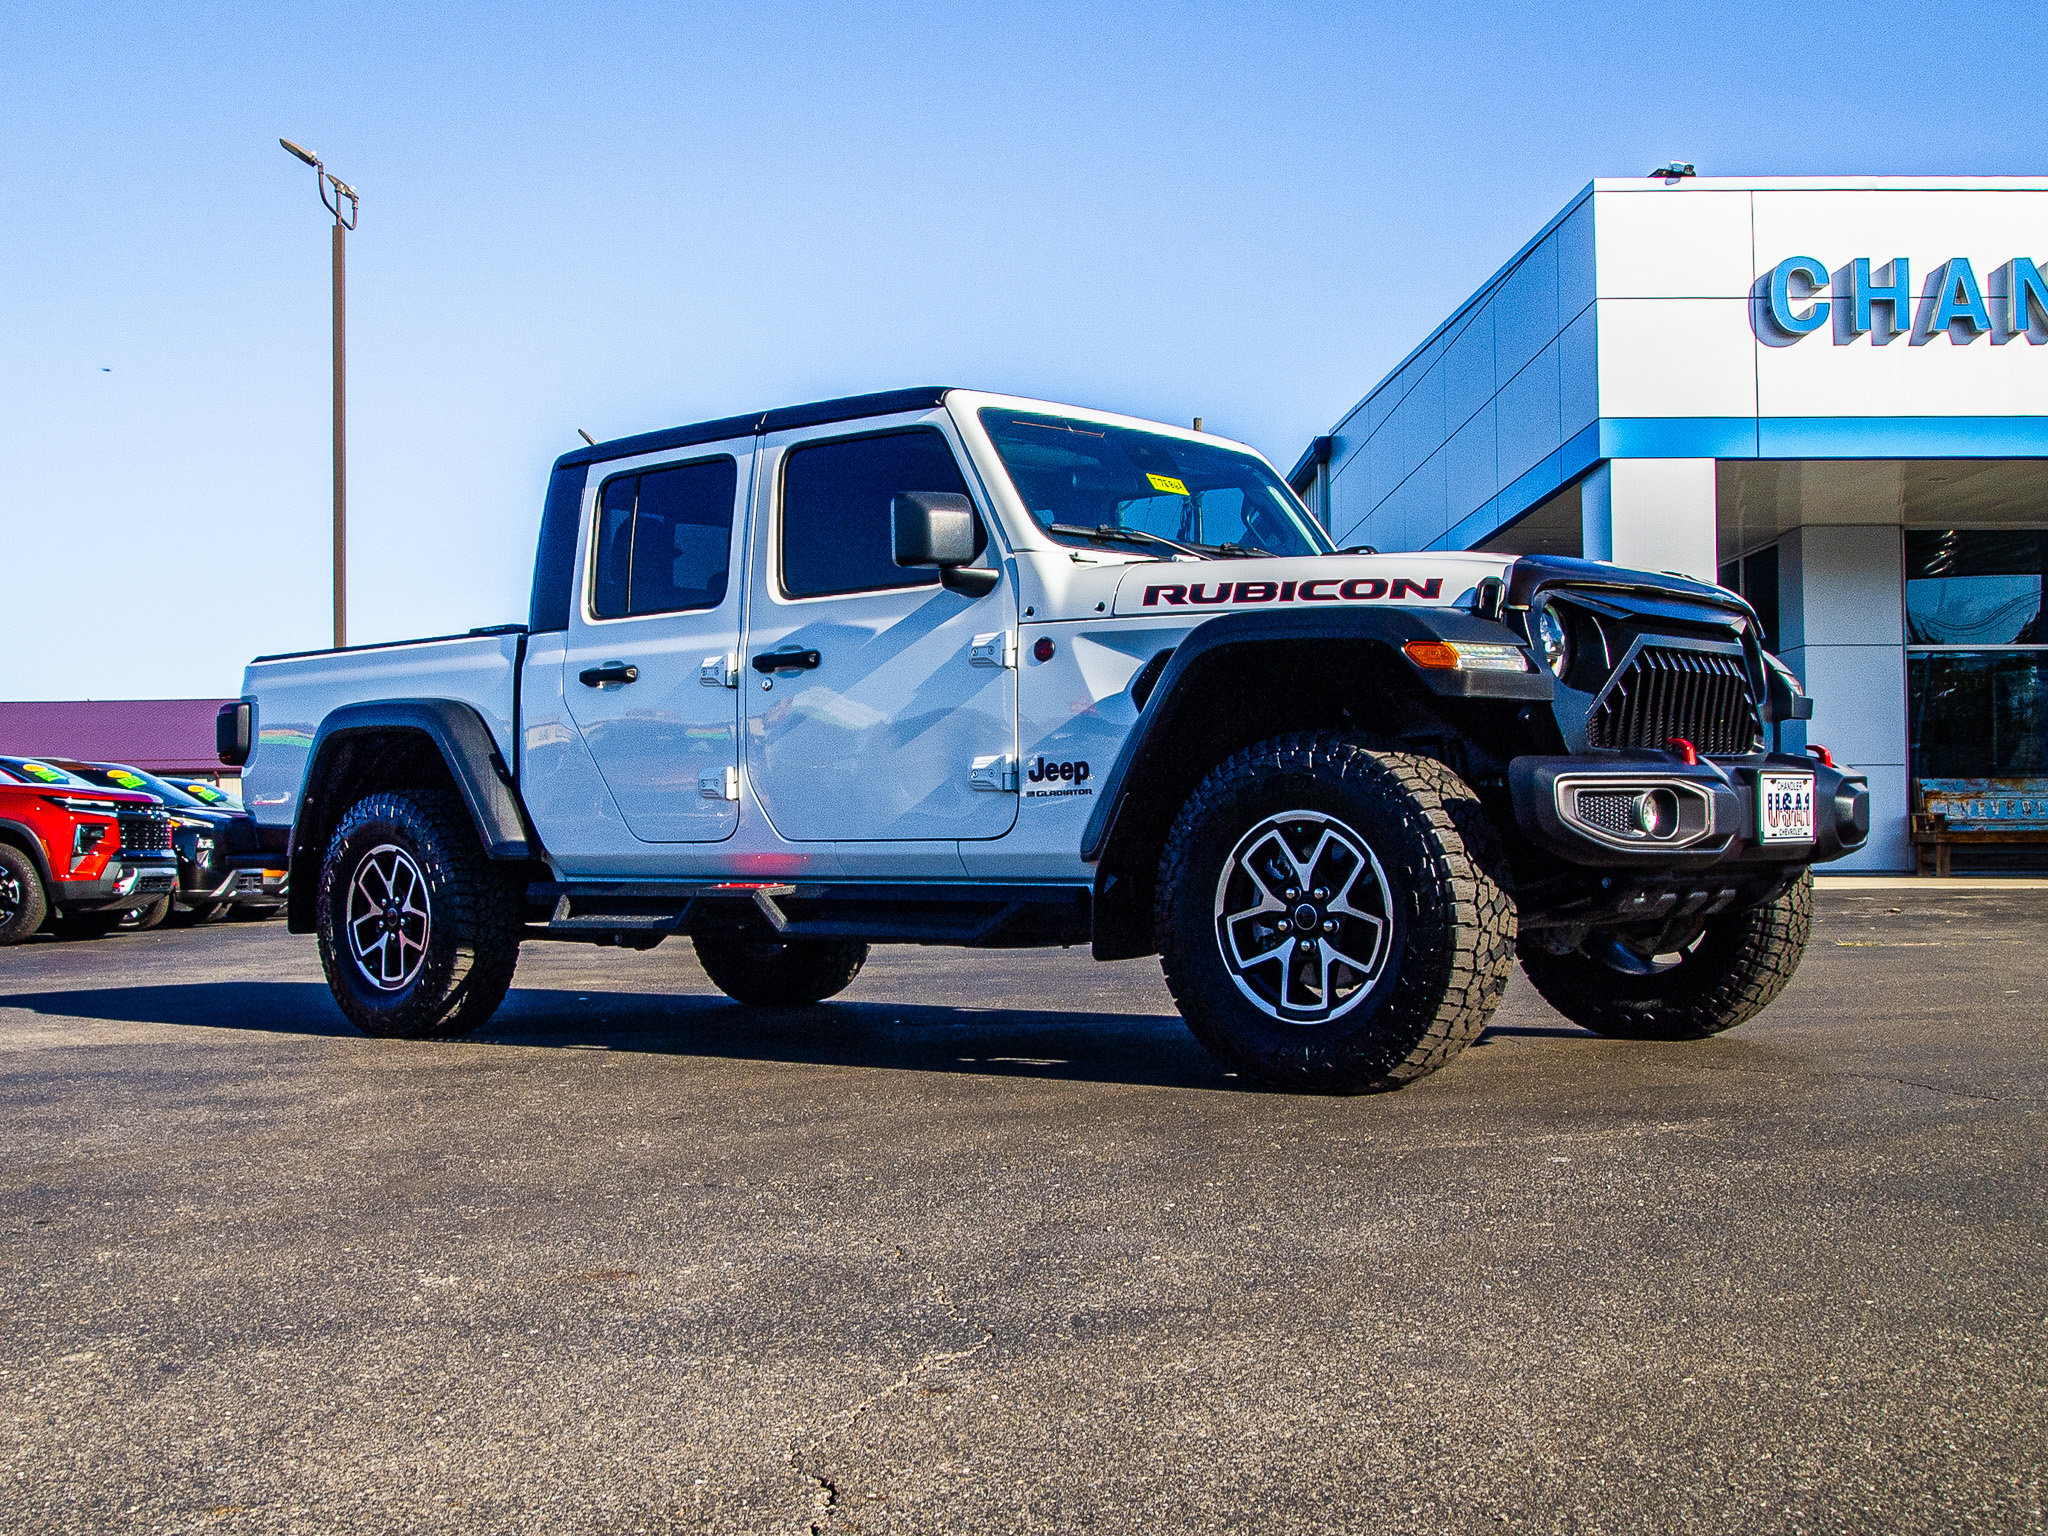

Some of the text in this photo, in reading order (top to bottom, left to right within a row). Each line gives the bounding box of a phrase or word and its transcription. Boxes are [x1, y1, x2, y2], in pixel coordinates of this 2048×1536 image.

[1142, 578, 1443, 606] RUBICON
[1028, 757, 1089, 785] Jeep
[1777, 781, 1802, 791] CHANDLER
[1036, 789, 1092, 797] GLADIATOR
[1779, 827, 1803, 836] CHEVROLET
